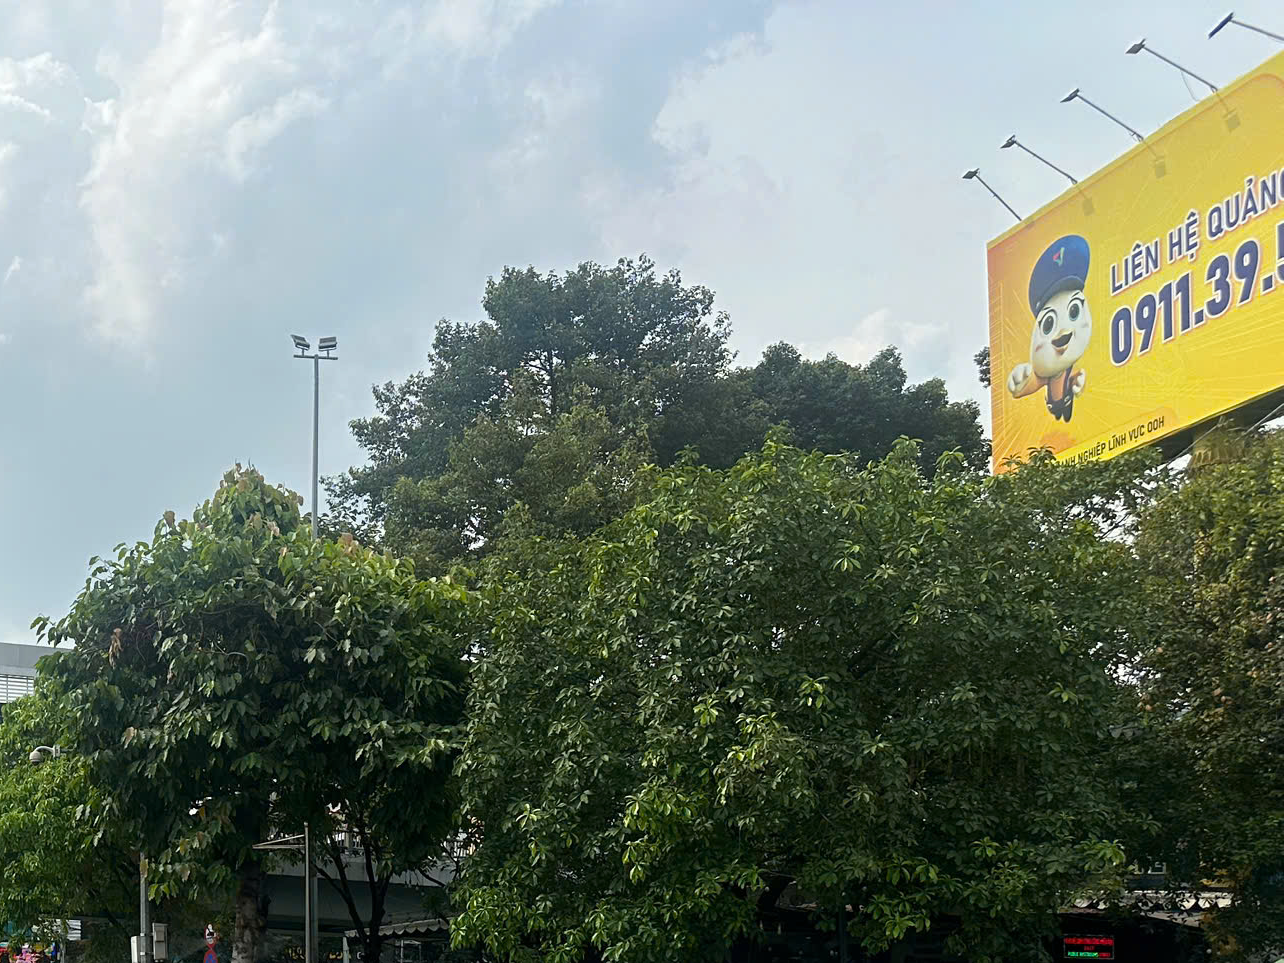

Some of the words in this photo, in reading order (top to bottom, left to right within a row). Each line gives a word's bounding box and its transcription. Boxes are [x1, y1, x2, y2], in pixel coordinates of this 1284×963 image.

[1111, 239, 1159, 294] LIÊN
[1168, 211, 1199, 261] HỆ
[1108, 434, 1127, 451] LĨNH
[1128, 424, 1145, 442] VỰC
[1147, 415, 1165, 433] OOH
